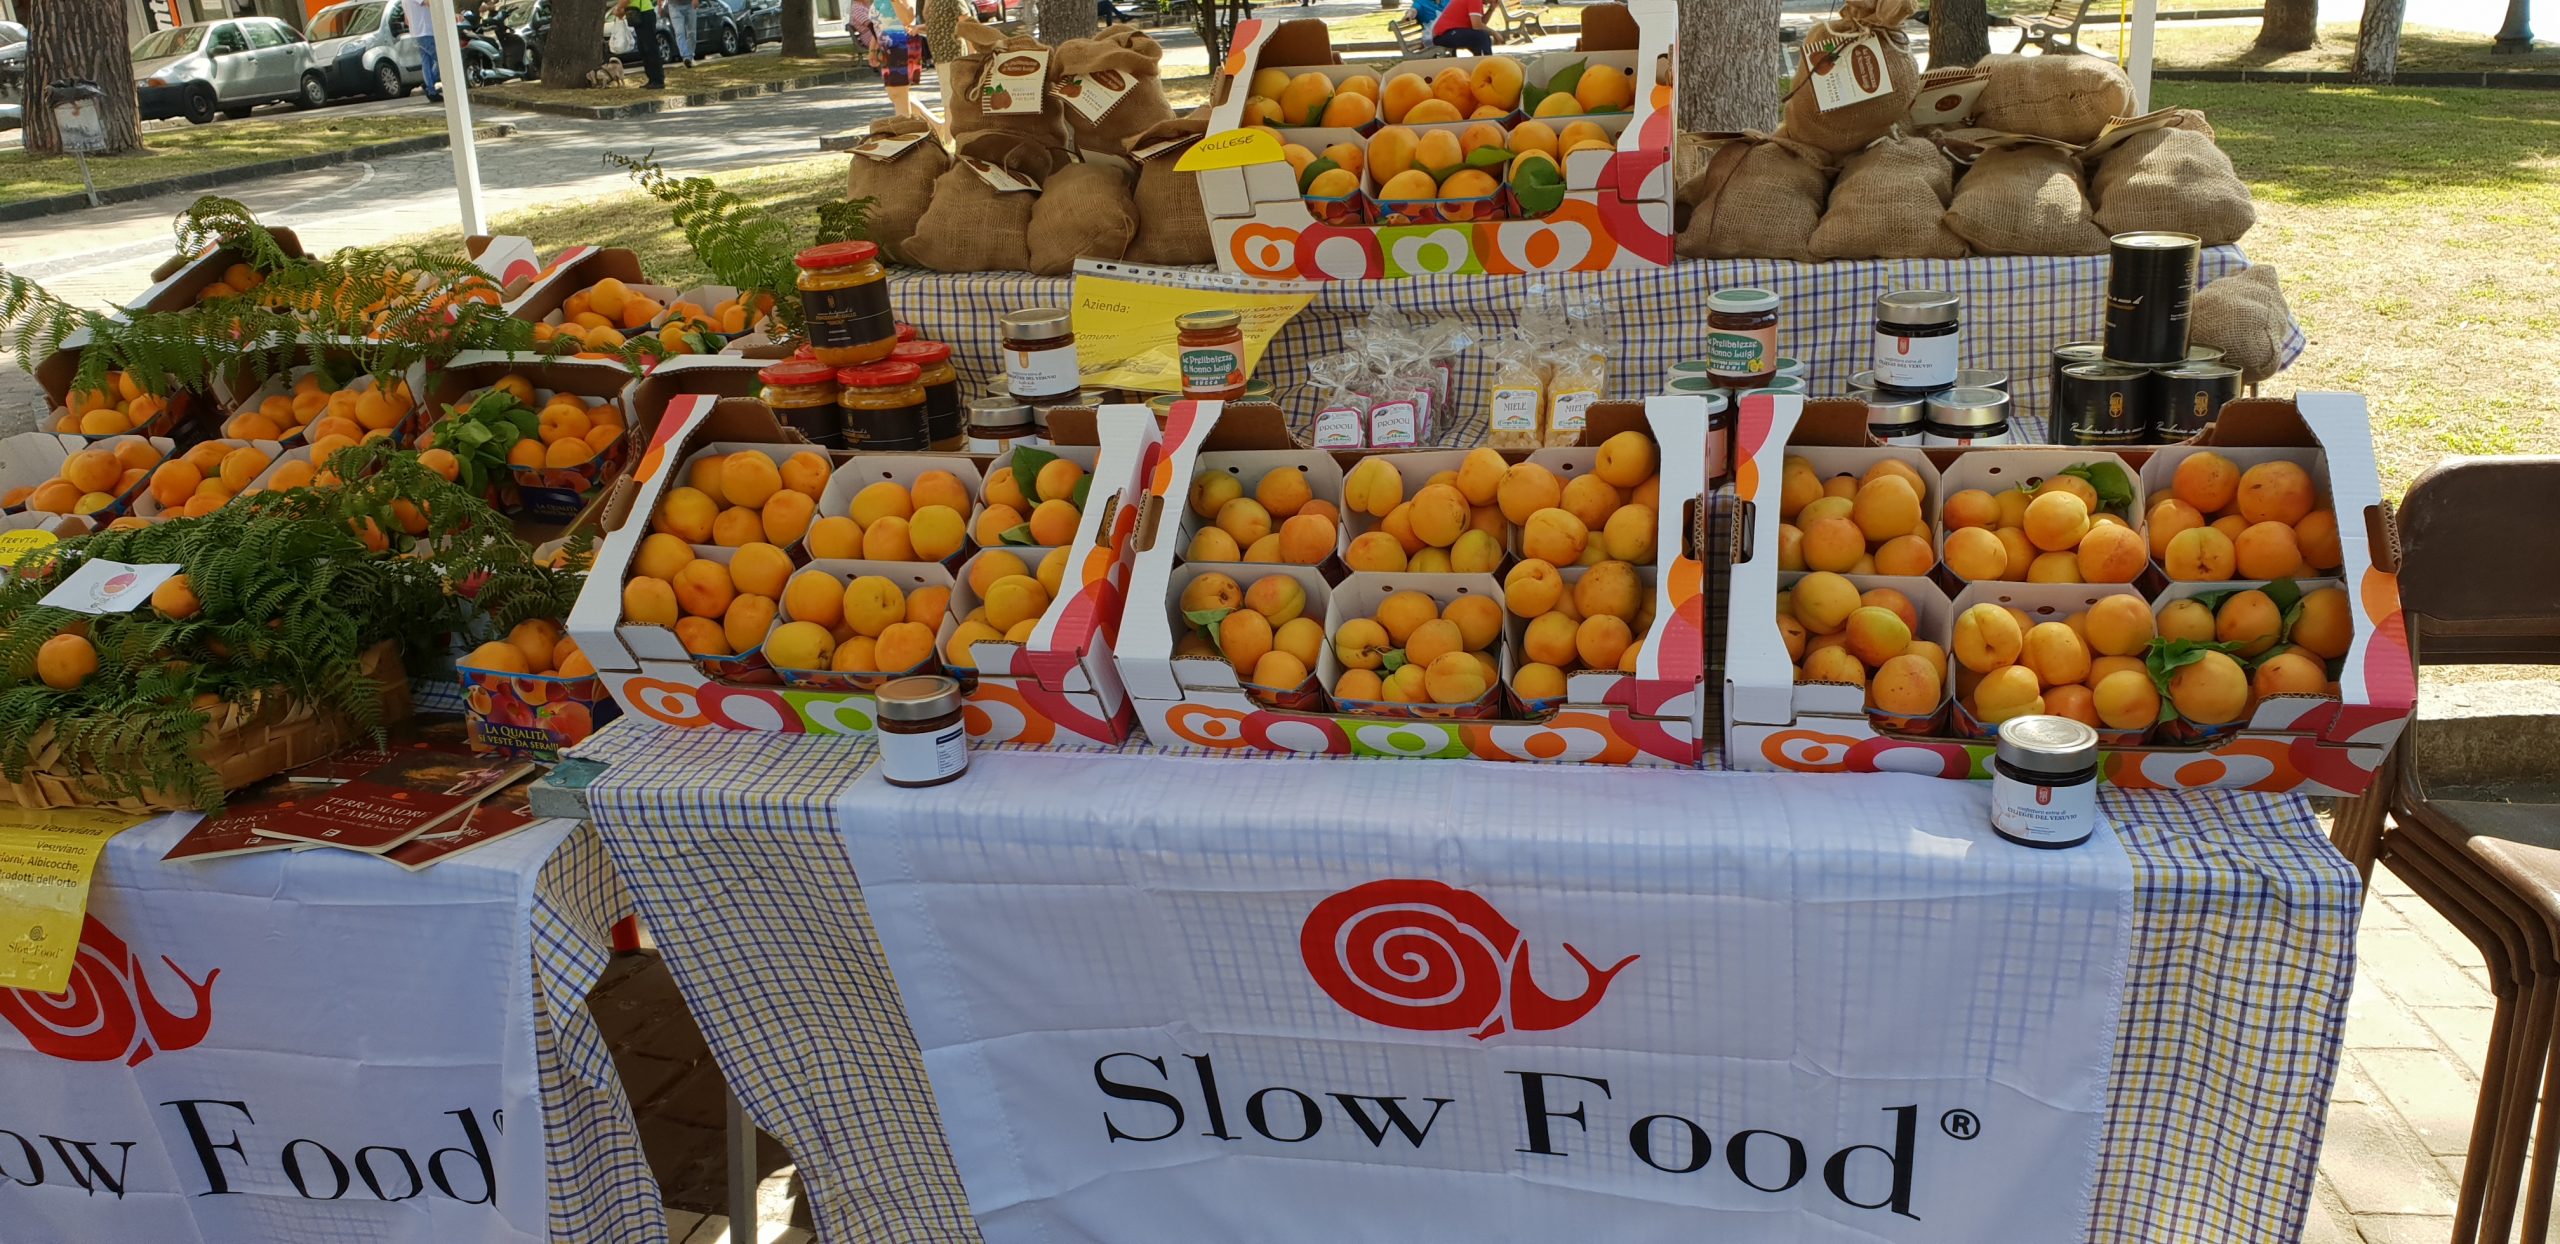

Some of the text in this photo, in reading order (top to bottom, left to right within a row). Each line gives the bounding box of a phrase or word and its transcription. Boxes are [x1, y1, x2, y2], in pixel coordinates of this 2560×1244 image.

[1199, 134, 1255, 152] VOLLESE
[1081, 298, 1131, 314] Azienda:
[1504, 402, 1527, 411] MIELE
[484, 724, 549, 741] LA QUALITÀ
[486, 735, 514, 746] VESTE
[515, 739, 529, 748] DA
[313, 804, 333, 814] IN
[334, 808, 412, 827] CAMPANIA
[325, 796, 373, 810] TERRA
[375, 804, 433, 819] MADRE
[41, 824, 103, 836] Vesuviana
[37, 840, 88, 855] Vesuviano:
[27, 855, 80, 874] Albicocche,
[36, 873, 77, 888] dell'orto
[1093, 1052, 1455, 1150] Slow
[1504, 1070, 1921, 1222] Food
[160, 1099, 500, 1209] Food
